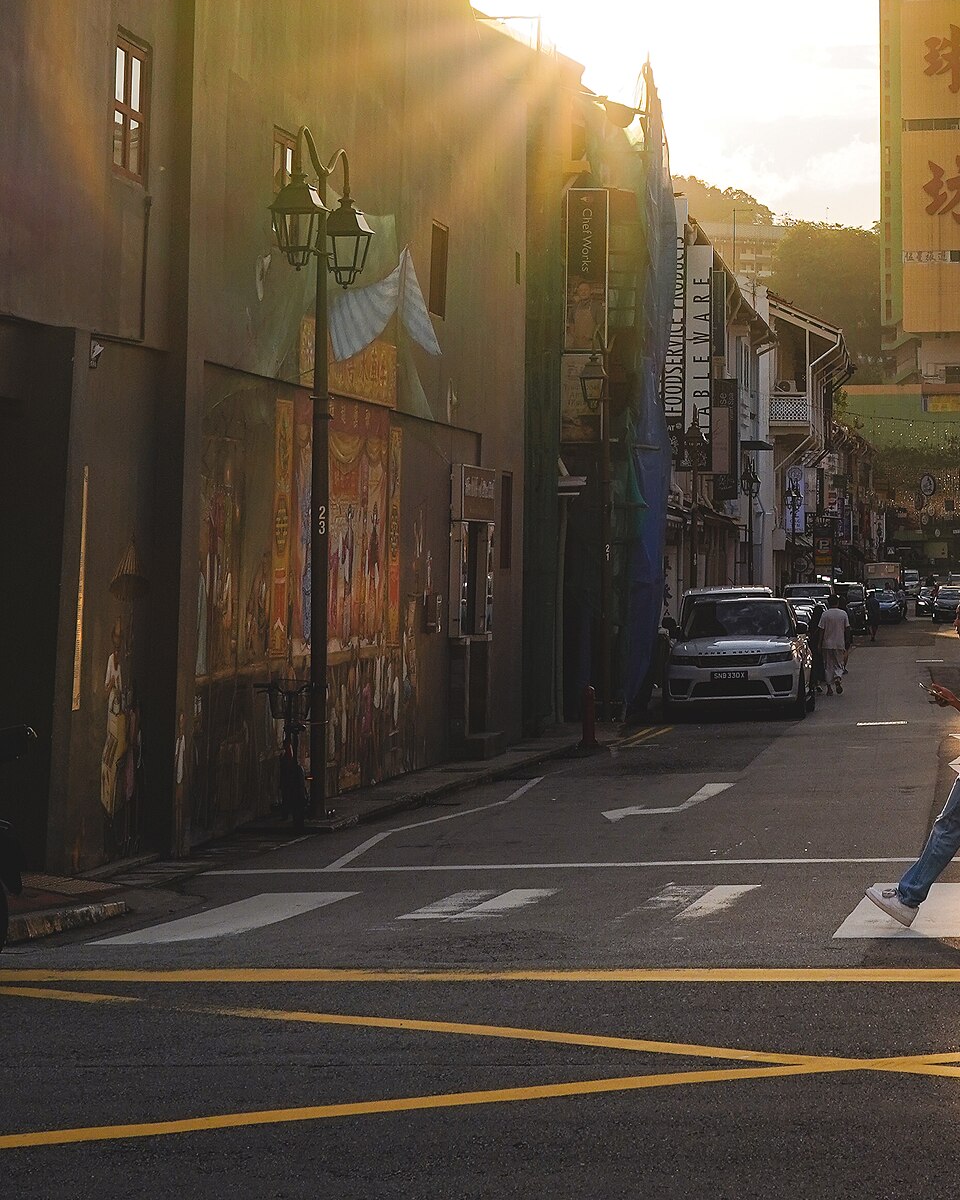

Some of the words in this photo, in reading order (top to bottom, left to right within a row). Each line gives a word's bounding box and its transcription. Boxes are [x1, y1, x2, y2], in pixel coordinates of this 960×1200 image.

[582, 208, 593, 235] Chef
[581, 235, 592, 272] Works
[692, 277, 710, 345] WARE
[318, 505, 326, 535] 23
[605, 543, 610, 561] 21
